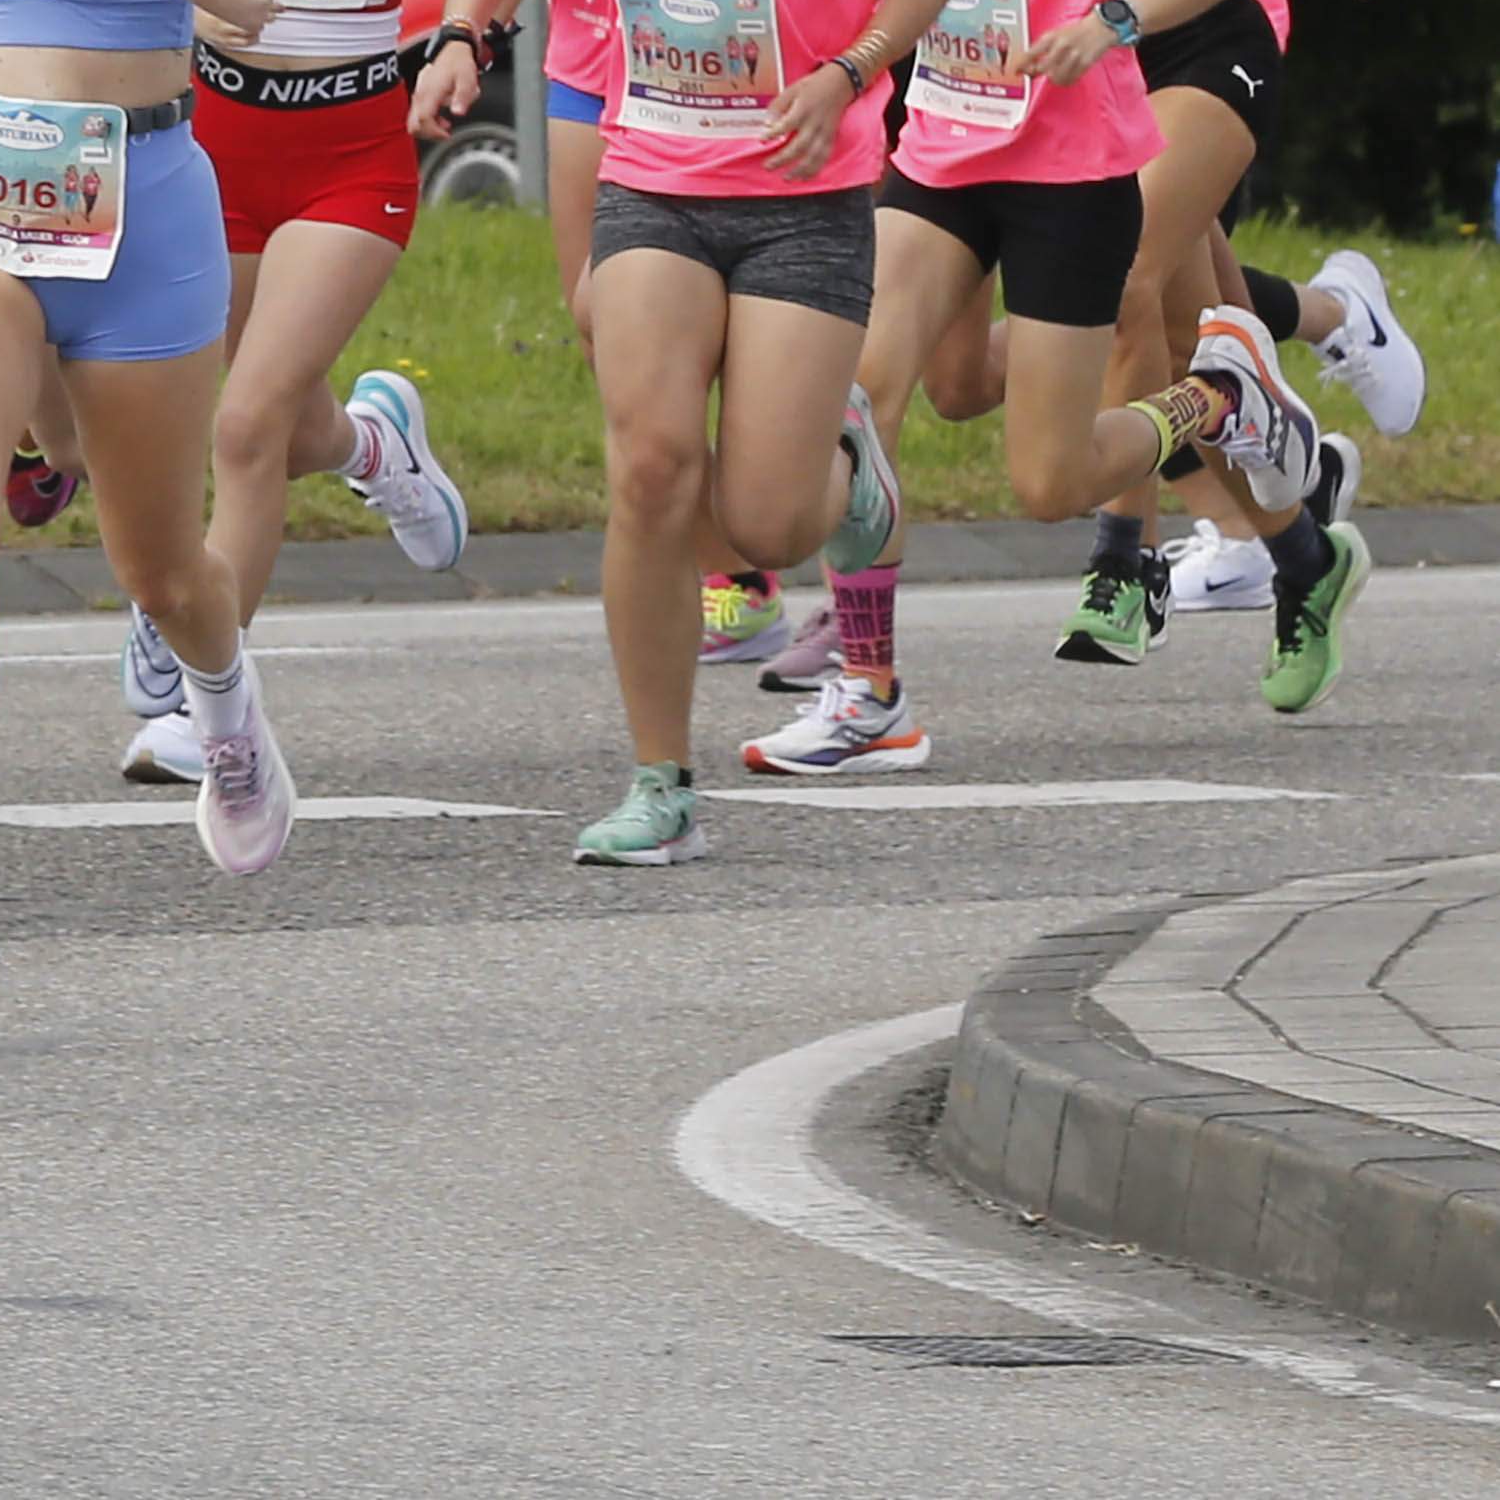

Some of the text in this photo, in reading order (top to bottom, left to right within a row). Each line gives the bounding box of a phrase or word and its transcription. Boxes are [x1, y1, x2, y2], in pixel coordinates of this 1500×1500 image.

[667, 46, 722, 76] 016
[940, 31, 981, 62] 016
[259, 69, 361, 103] NIKE
